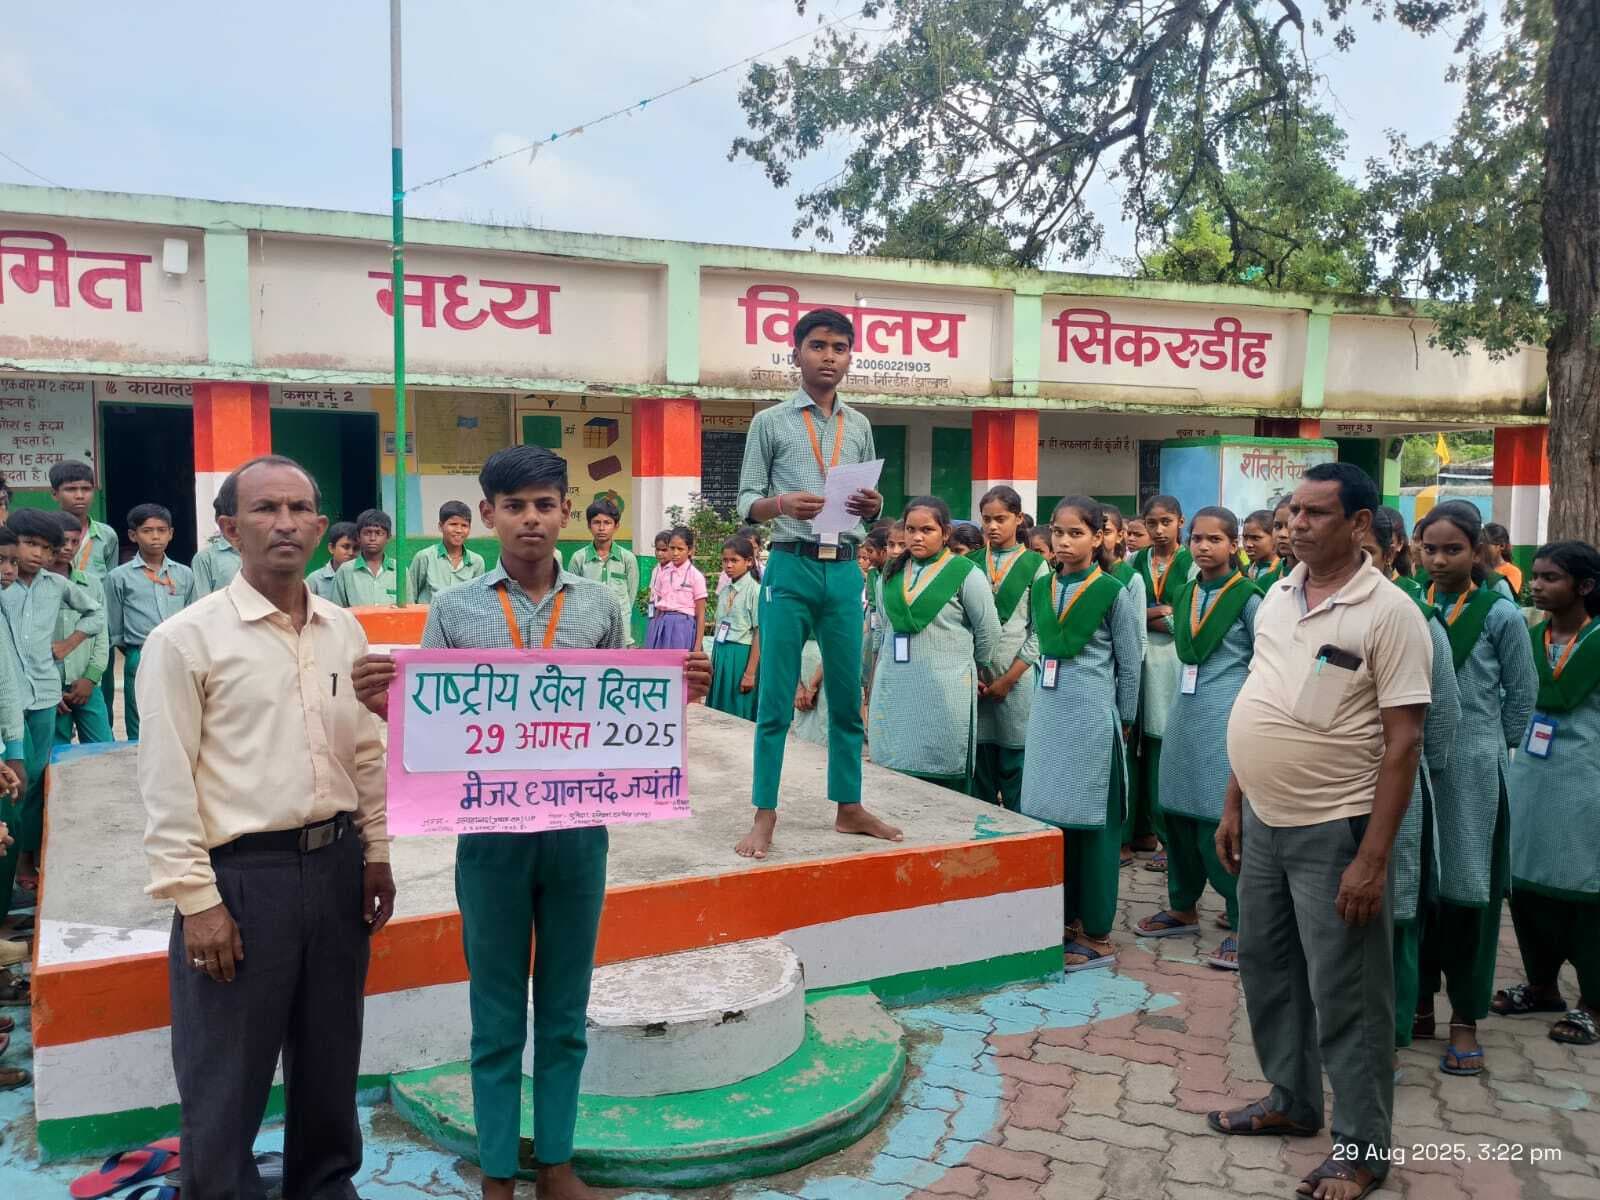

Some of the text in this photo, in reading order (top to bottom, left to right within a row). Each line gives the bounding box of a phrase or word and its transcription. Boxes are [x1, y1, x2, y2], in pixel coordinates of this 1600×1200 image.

[368, 271, 560, 334] मध्य
[1052, 308, 1272, 378] सिकरुडीह
[856, 358, 931, 372] 20060221903
[344, 391, 354, 402] 2
[19, 454, 32, 466] 15
[1240, 448, 1286, 482] शीतल
[412, 664, 671, 715] राष्ट्रीय खेल दिवस
[465, 724, 505, 754] 29
[515, 721, 591, 750] अगस्त
[460, 771, 519, 810] मेजर
[619, 767, 683, 800] जयंती
